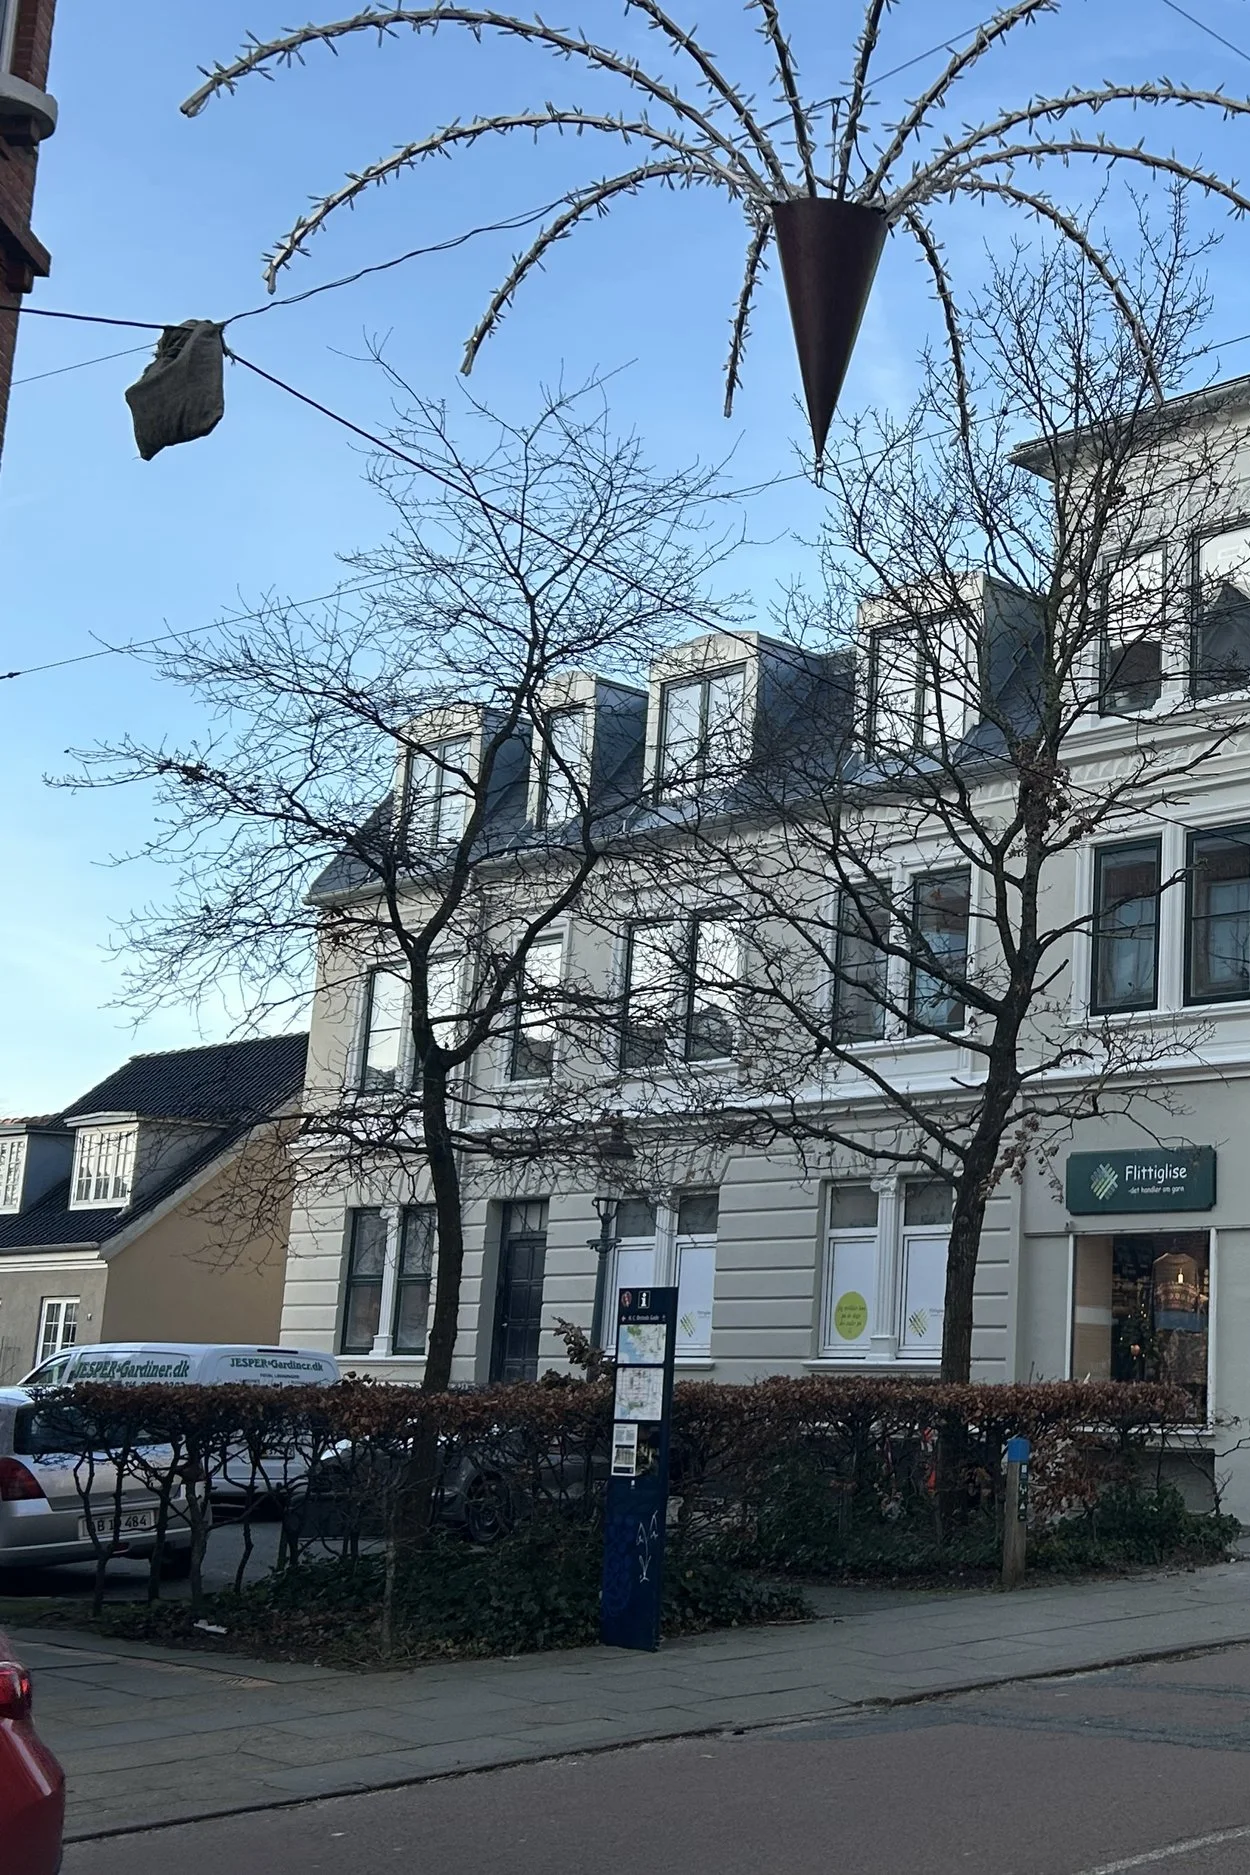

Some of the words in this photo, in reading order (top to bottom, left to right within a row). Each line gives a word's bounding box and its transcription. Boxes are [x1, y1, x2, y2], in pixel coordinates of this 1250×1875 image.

[1125, 1163, 1188, 1184] Flittiglise
[1141, 1185, 1161, 1193] handler
[1172, 1186, 1184, 1194] garn
[125, 1514, 147, 1528] 484
